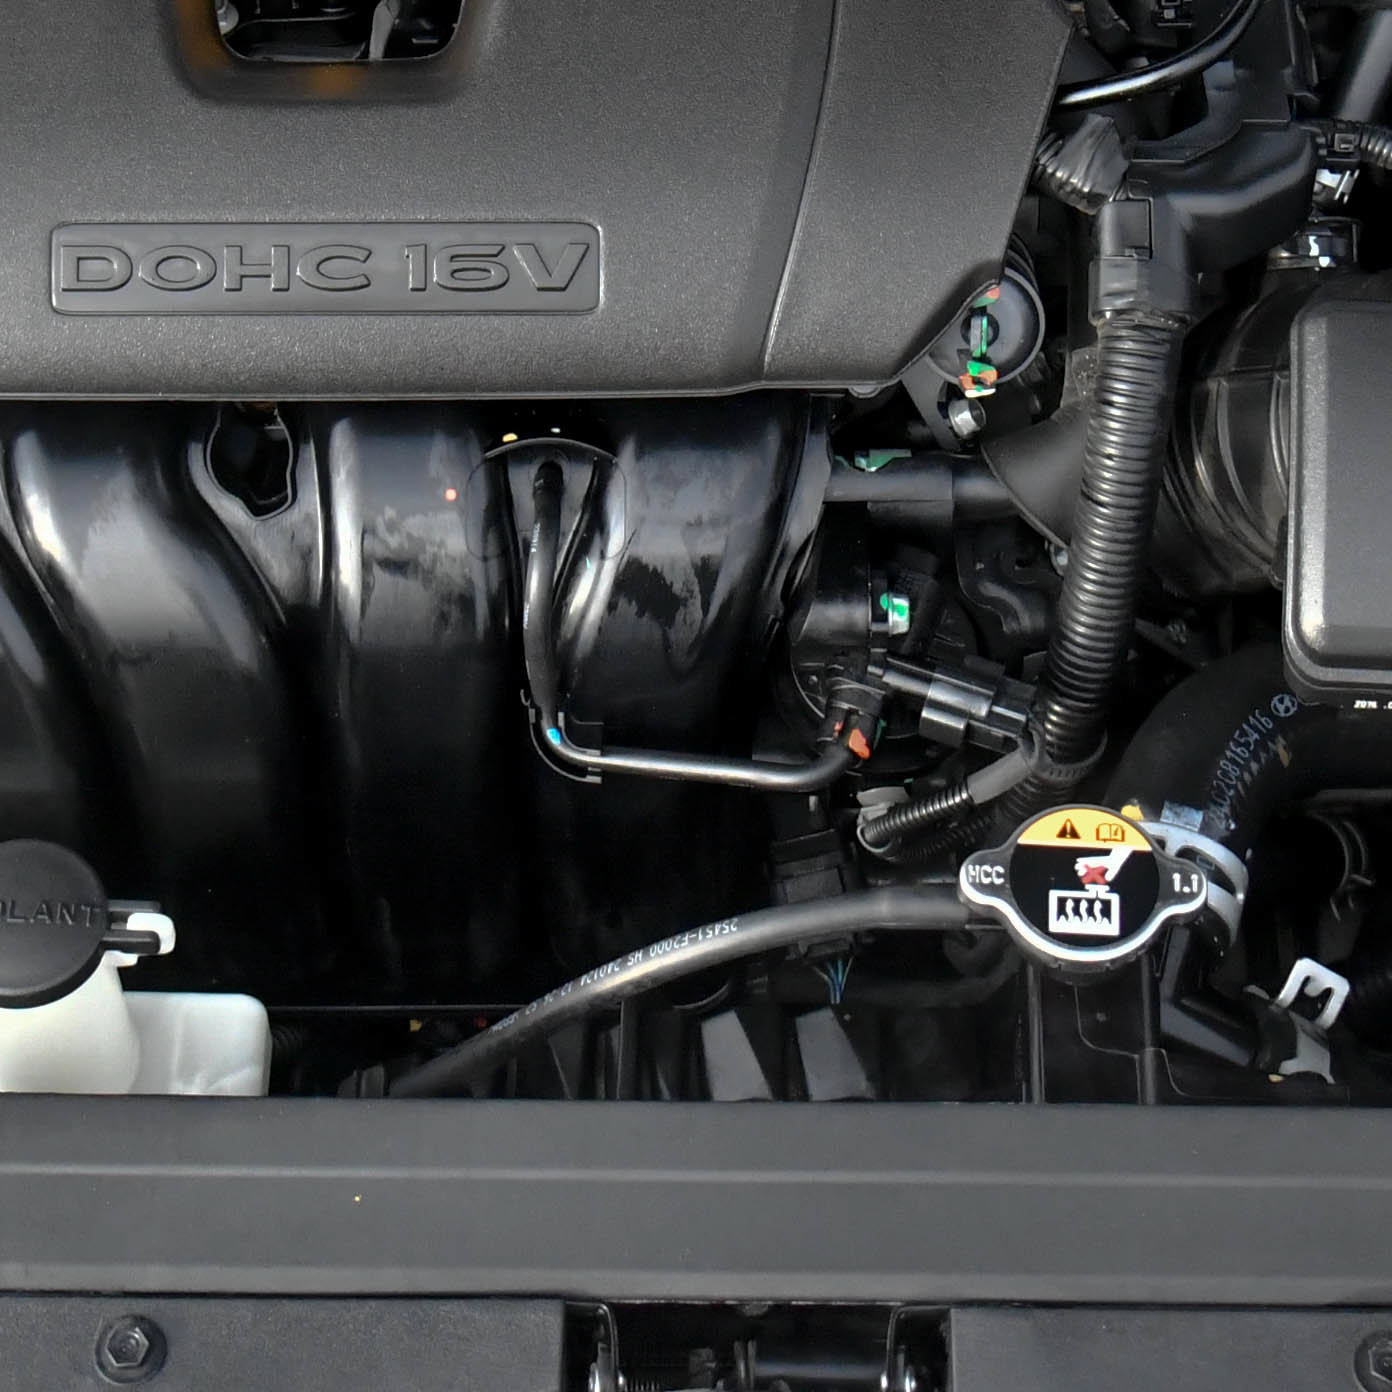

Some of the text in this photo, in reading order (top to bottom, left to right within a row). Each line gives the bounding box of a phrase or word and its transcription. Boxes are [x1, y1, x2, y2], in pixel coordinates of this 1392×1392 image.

[60, 242, 596, 293] DOHC 16V
[966, 863, 1006, 886] HCC
[1171, 871, 1200, 894] 1.1
